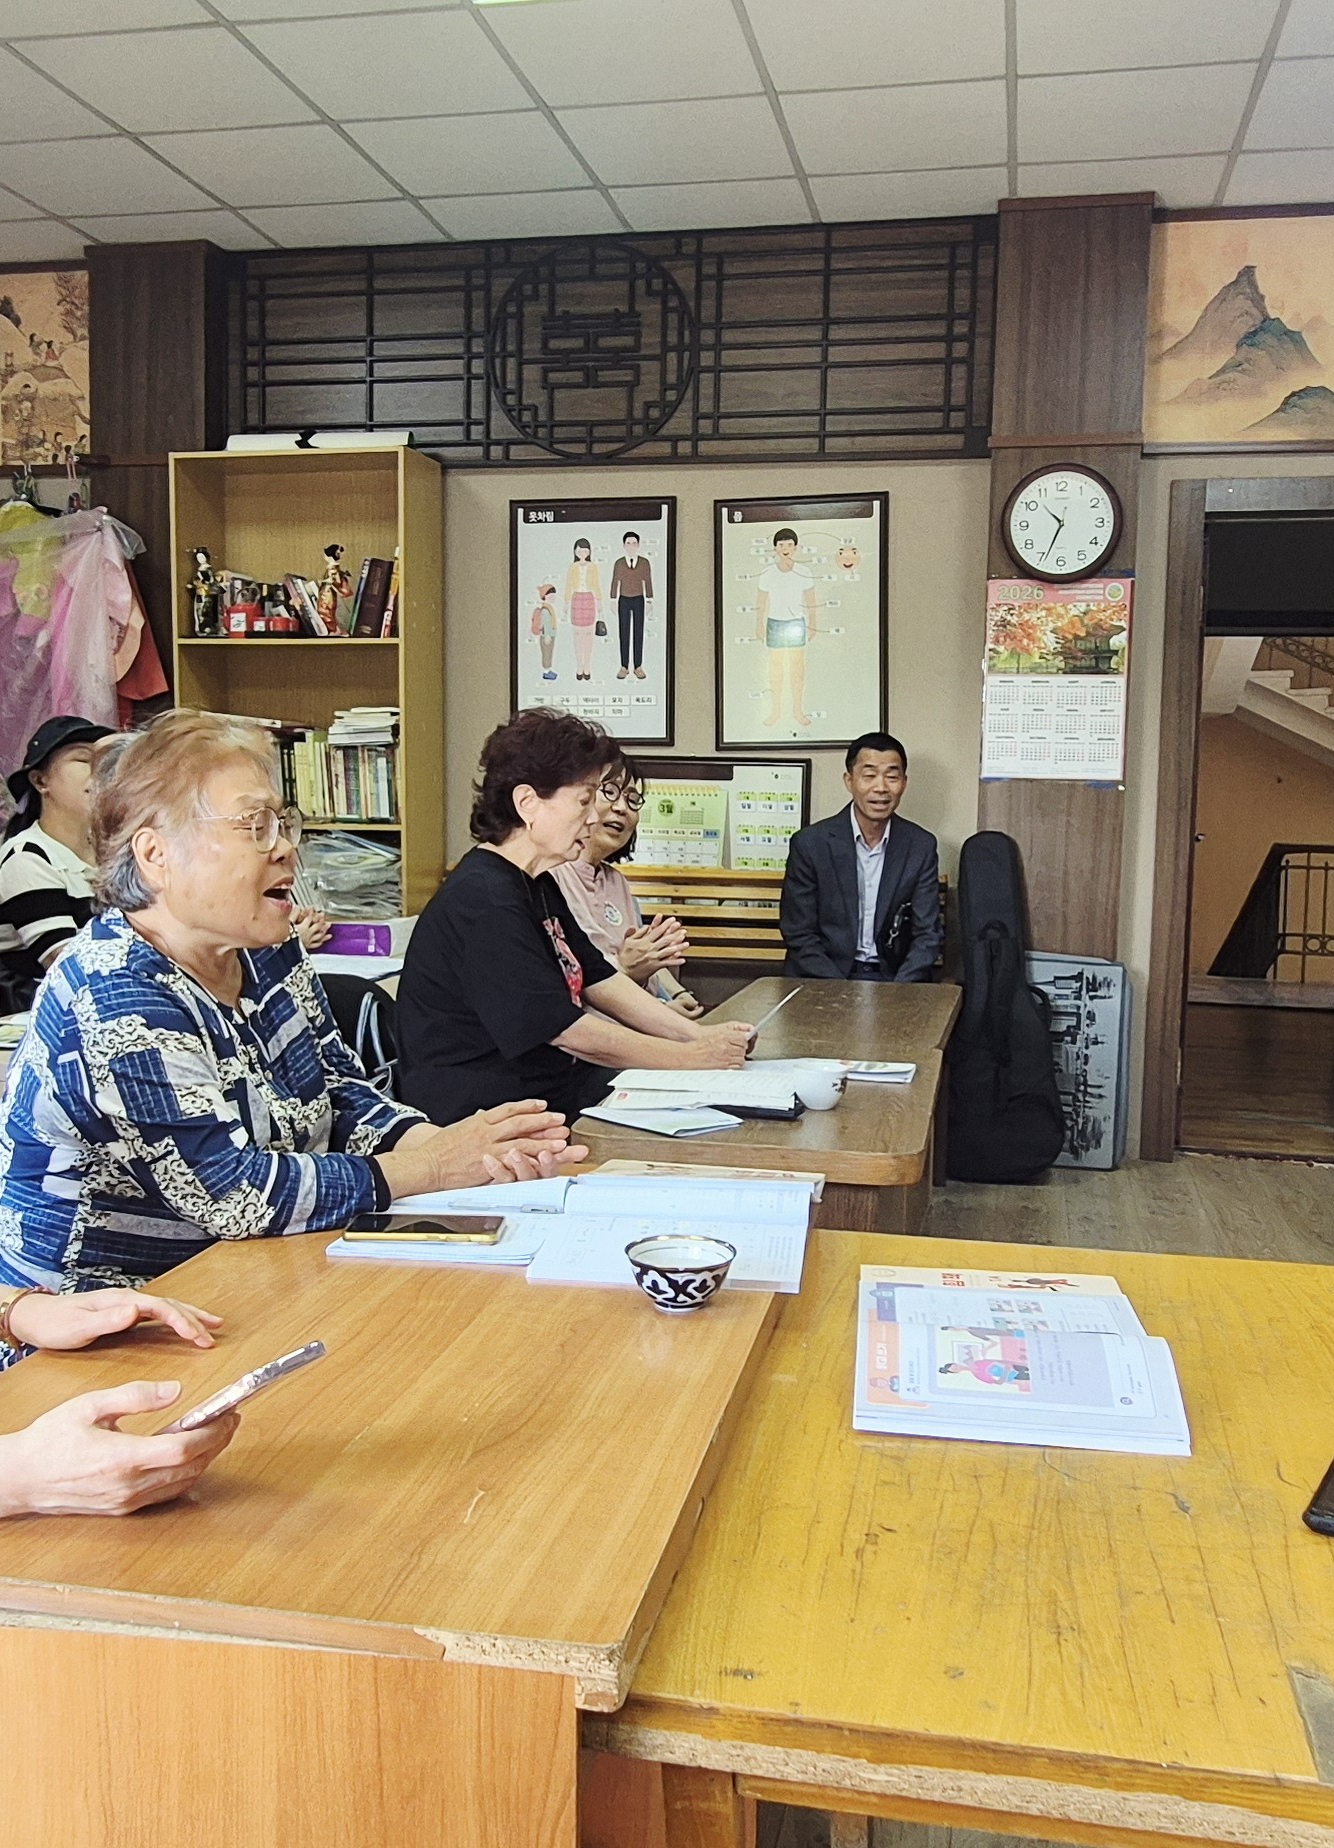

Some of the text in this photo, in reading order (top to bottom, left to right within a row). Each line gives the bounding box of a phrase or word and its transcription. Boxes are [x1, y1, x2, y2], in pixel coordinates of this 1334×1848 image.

[1055, 480, 1069, 492] 12
[1038, 487, 1048, 498] 11
[1024, 500, 1039, 511] 10
[1089, 497, 1100, 508] 2
[528, 510, 555, 523] 옷차림
[1018, 520, 1030, 531] 9
[1094, 517, 1105, 528] 3
[1024, 539, 1034, 550] 8
[1089, 536, 1099, 546] 4
[1036, 551, 1046, 562] 7
[1077, 550, 1087, 561] 5
[1056, 556, 1067, 567] 6
[997, 584, 1045, 601] 2026
[658, 803, 674, 814] 3월
